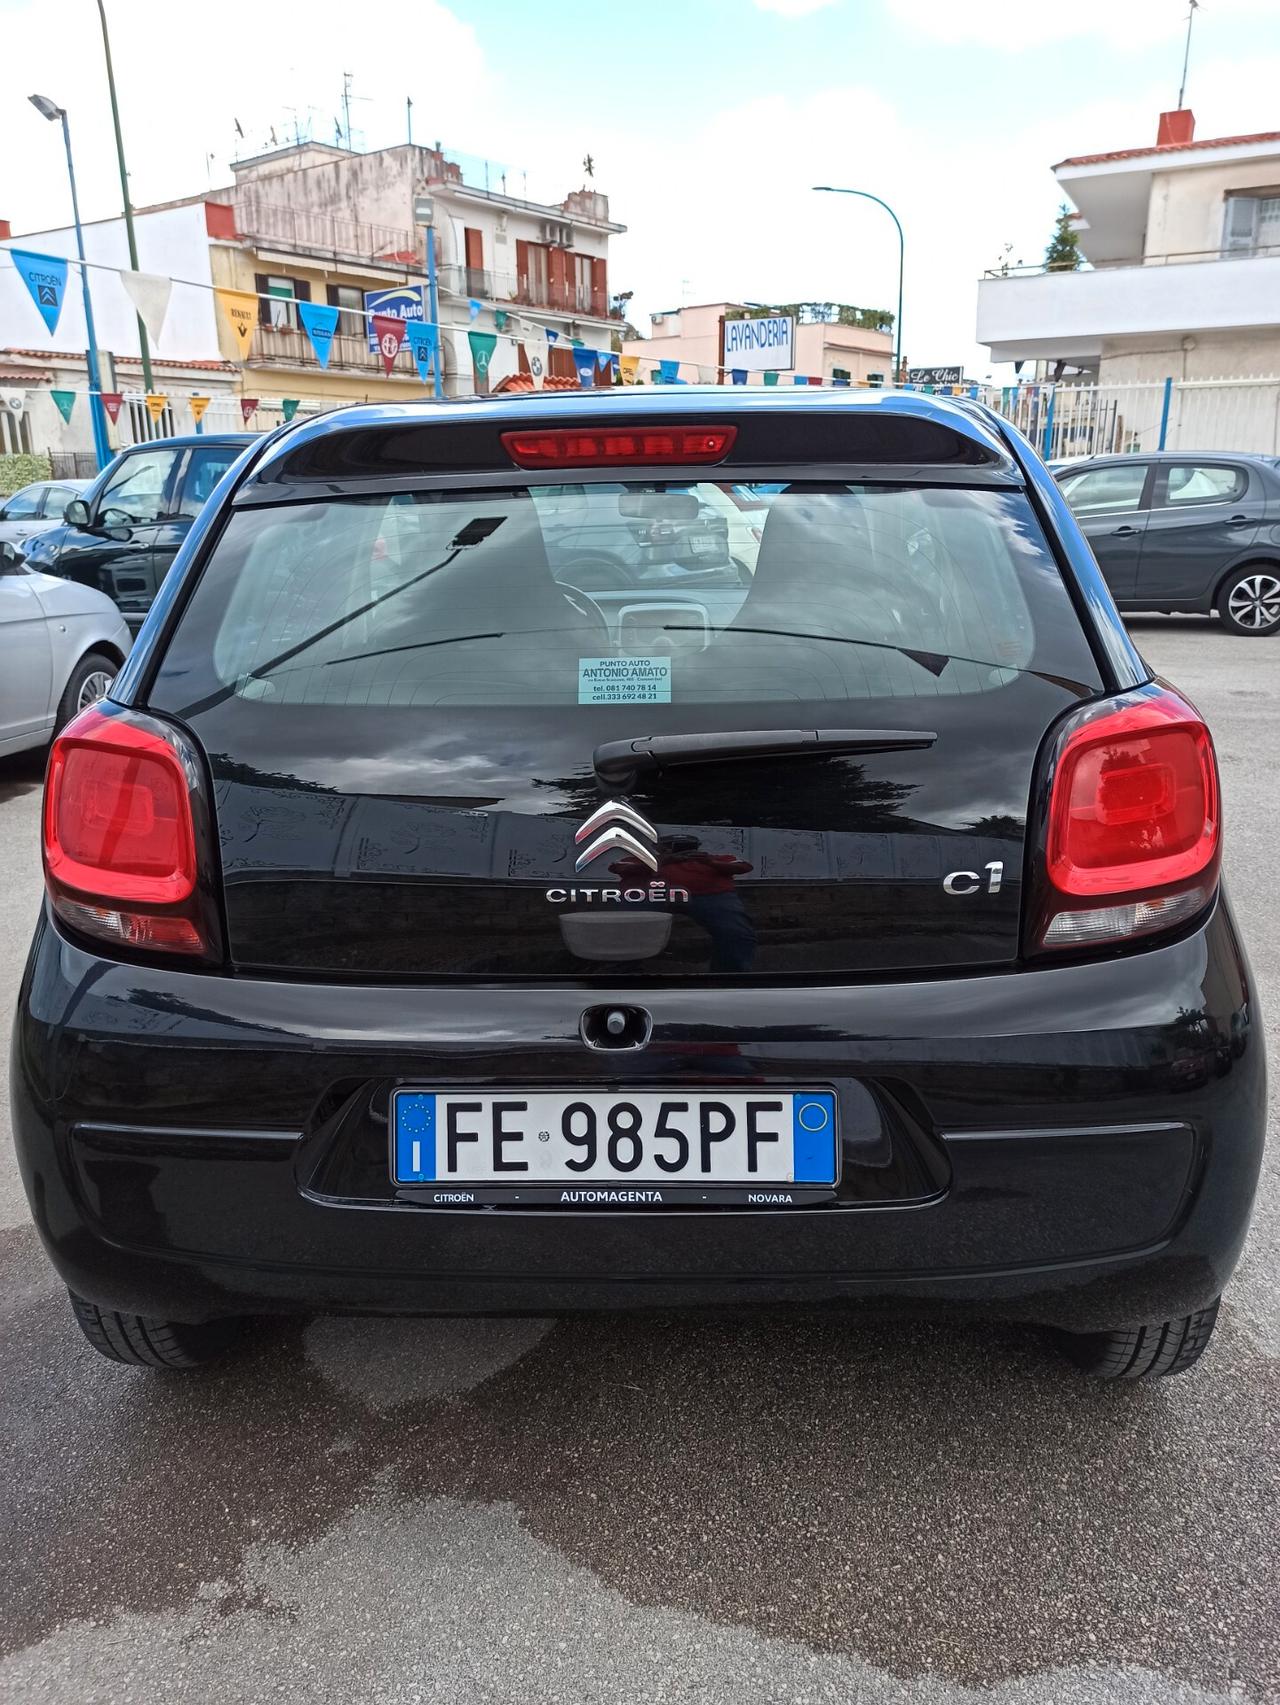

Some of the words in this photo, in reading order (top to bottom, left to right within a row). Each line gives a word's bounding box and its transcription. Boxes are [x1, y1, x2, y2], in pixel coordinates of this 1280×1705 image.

[400, 304, 423, 319] Auto
[726, 318, 788, 352] LAVANDERIA
[911, 370, 931, 383] Le
[932, 369, 958, 382] Chic
[631, 667, 668, 677] AMATO
[545, 881, 690, 903] CITROËN
[447, 1101, 528, 1173] FE
[561, 1101, 783, 1173] 985PF
[433, 1191, 475, 1203] CITROËN
[560, 1191, 663, 1202] AUTOMAGENTA
[748, 1194, 793, 1204] NOVARA
